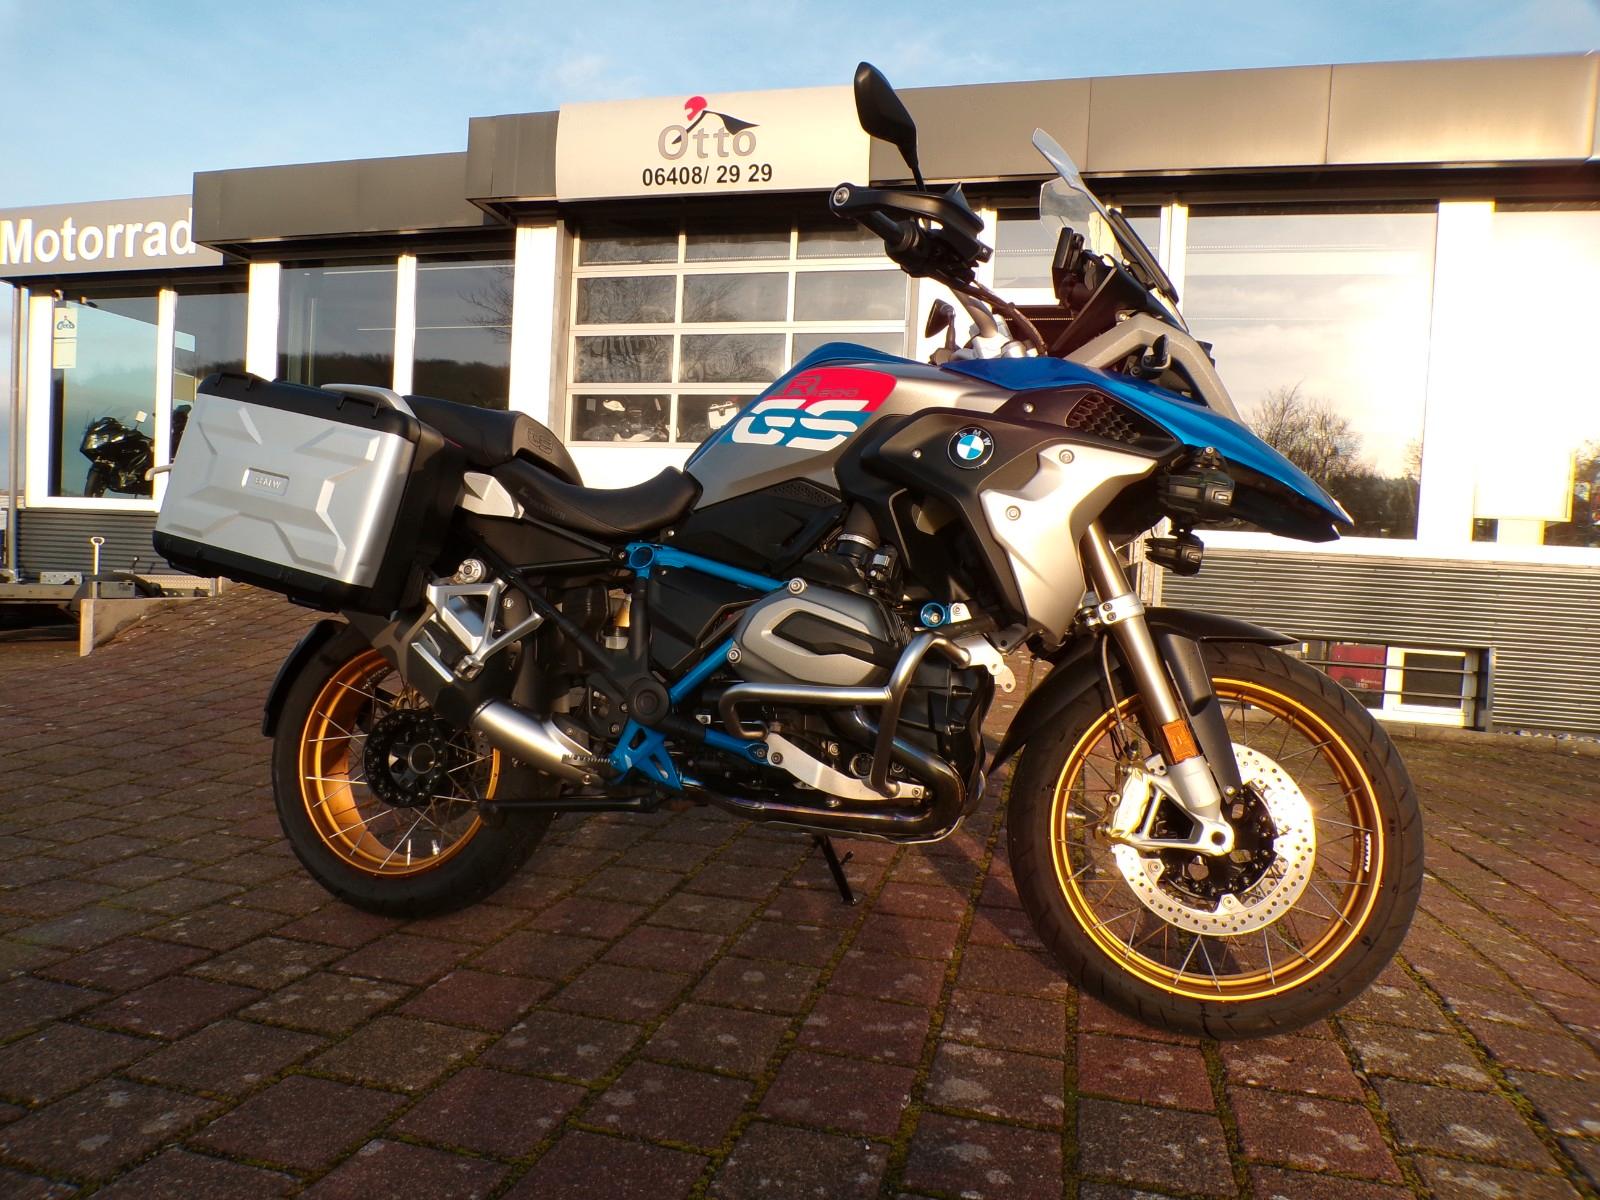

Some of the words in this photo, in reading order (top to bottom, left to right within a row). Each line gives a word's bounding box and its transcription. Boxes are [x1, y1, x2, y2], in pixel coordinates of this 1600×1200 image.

[658, 124, 757, 160] Otto
[642, 165, 709, 186] 06408/
[716, 164, 741, 184] 29
[748, 163, 773, 183] 29
[0, 207, 196, 265] Motorrad
[732, 399, 869, 451] GS
[958, 429, 992, 446] BMW
